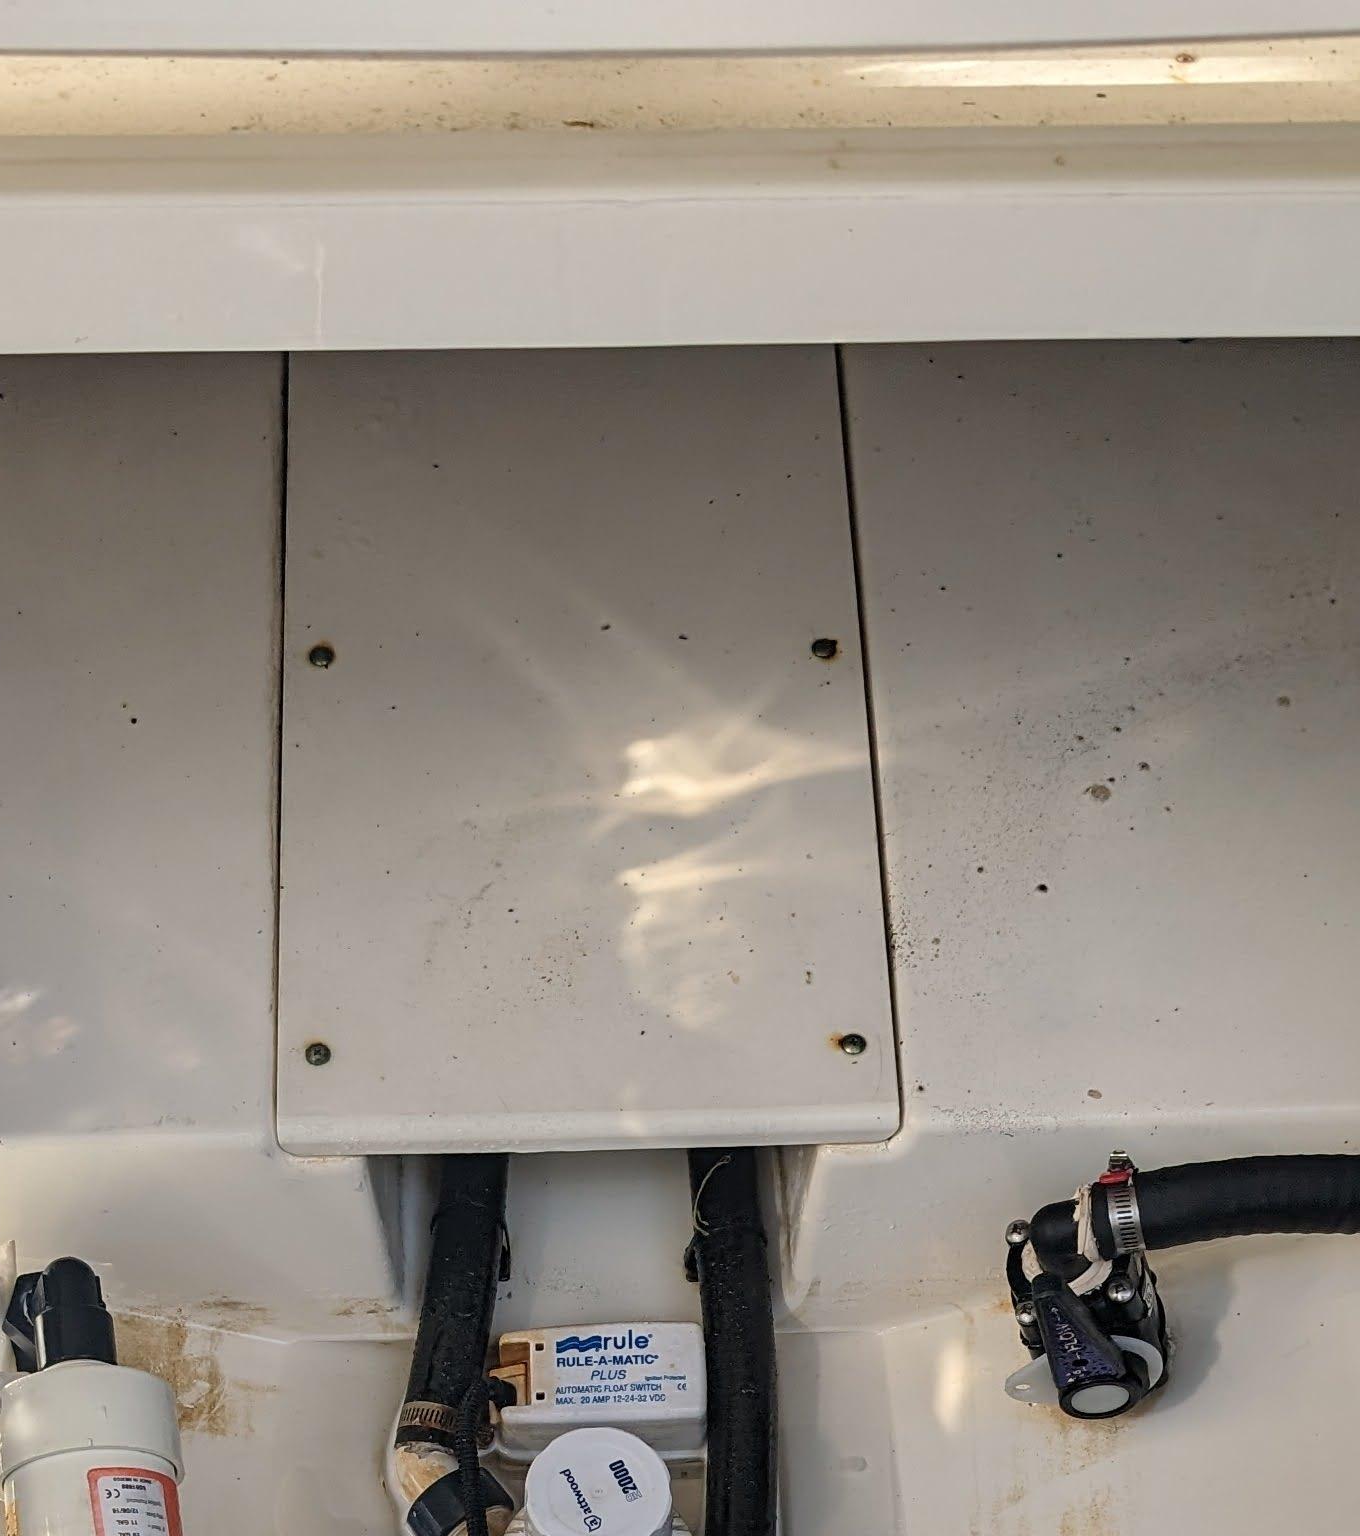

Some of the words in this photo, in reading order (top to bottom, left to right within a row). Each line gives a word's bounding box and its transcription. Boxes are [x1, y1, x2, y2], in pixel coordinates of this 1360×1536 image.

[590, 1369, 627, 1381] PLUS
[555, 1384, 603, 1395] AUTOMATIC
[604, 1383, 629, 1393] FLOAT
[629, 1382, 663, 1392] SWITCH
[580, 1395, 590, 1405] 20
[592, 1394, 611, 1404] AMP
[612, 1394, 647, 1403] 12-24-32
[649, 1393, 666, 1402] VDC
[608, 1459, 639, 1495] 2000
[559, 1468, 593, 1515] attwood
